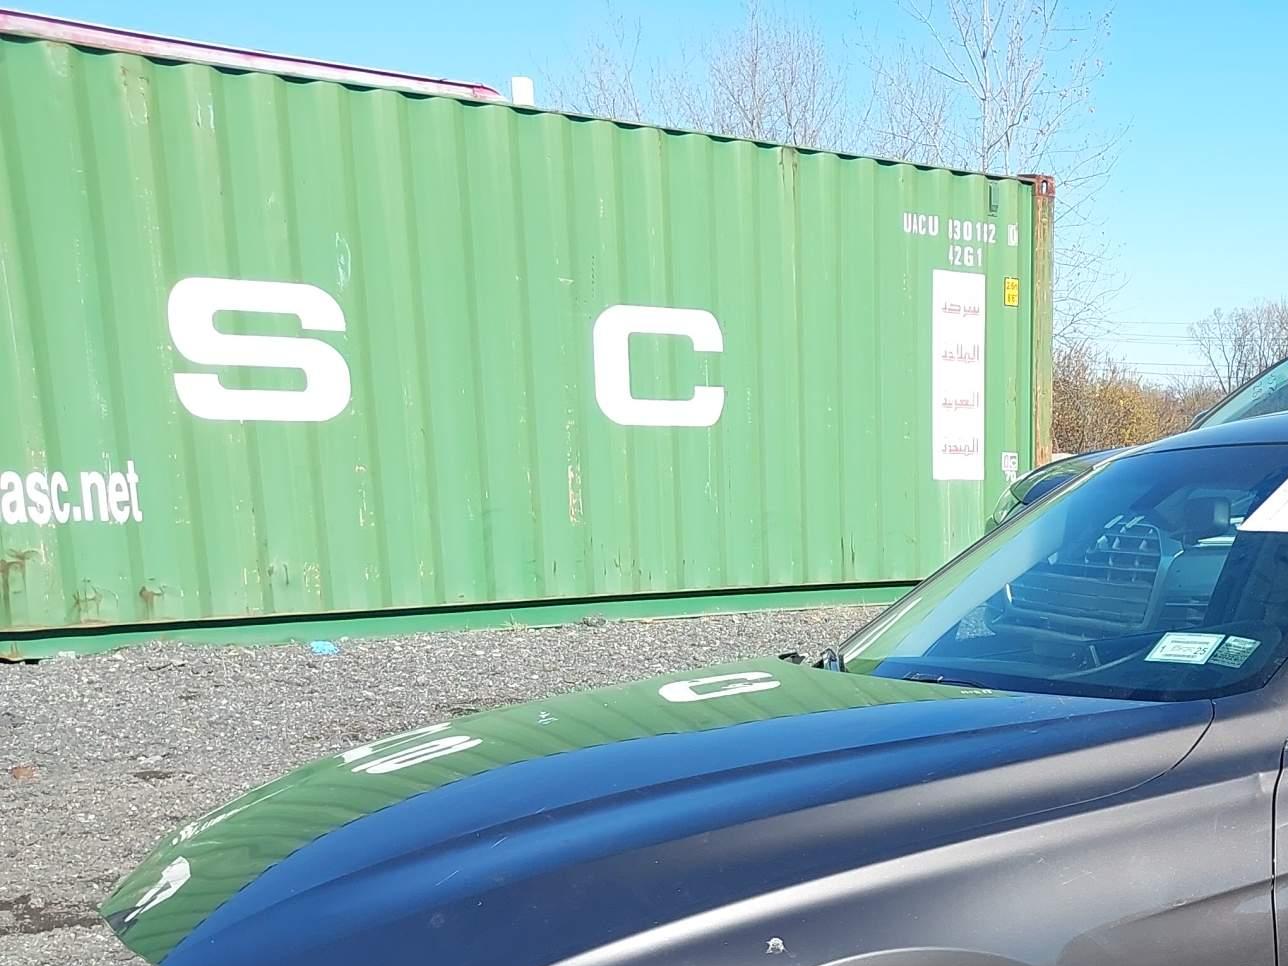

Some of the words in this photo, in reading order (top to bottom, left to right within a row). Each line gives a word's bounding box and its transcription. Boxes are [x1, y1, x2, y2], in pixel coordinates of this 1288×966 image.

[903, 212, 939, 236] UACU
[168, 277, 352, 421] S
[593, 304, 725, 427] C
[0, 459, 143, 525] asc.net
